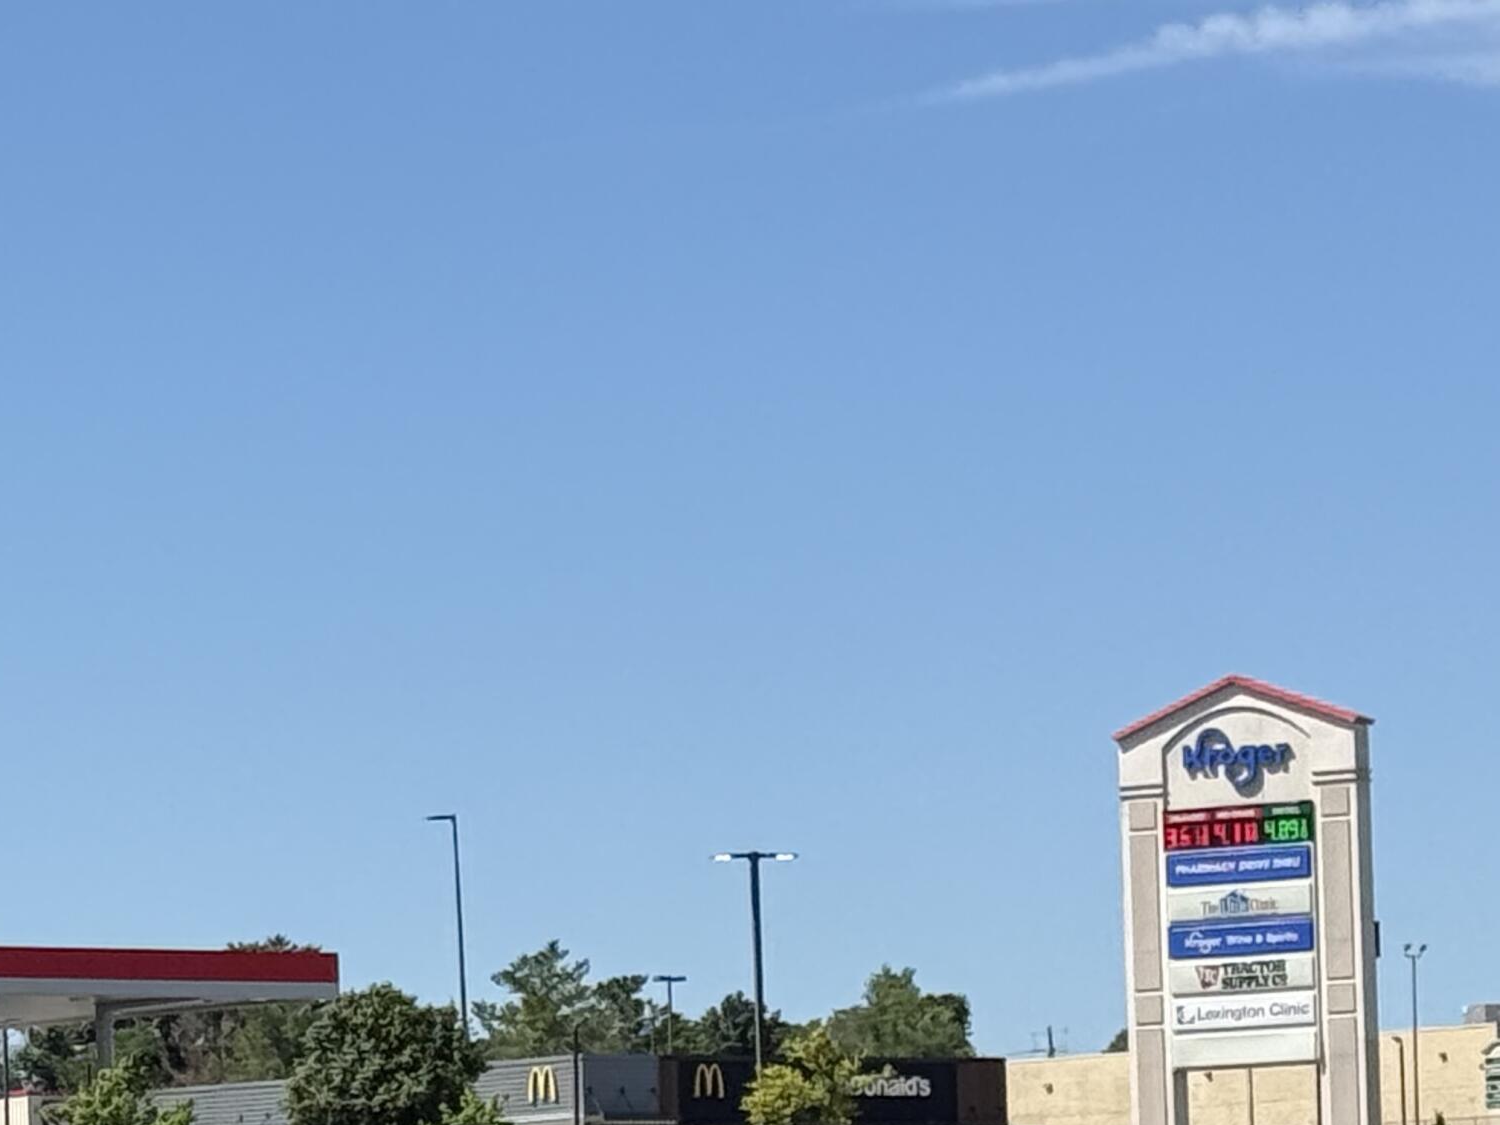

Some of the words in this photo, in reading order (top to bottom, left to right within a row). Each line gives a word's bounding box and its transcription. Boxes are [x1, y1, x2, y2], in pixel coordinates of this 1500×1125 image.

[1182, 728, 1292, 794] Kroger
[1221, 960, 1286, 977] TRACTOR
[1221, 974, 1270, 990] SUPPLY
[1197, 1005, 1266, 1022] Lexington
[1269, 1002, 1310, 1017] Clinic
